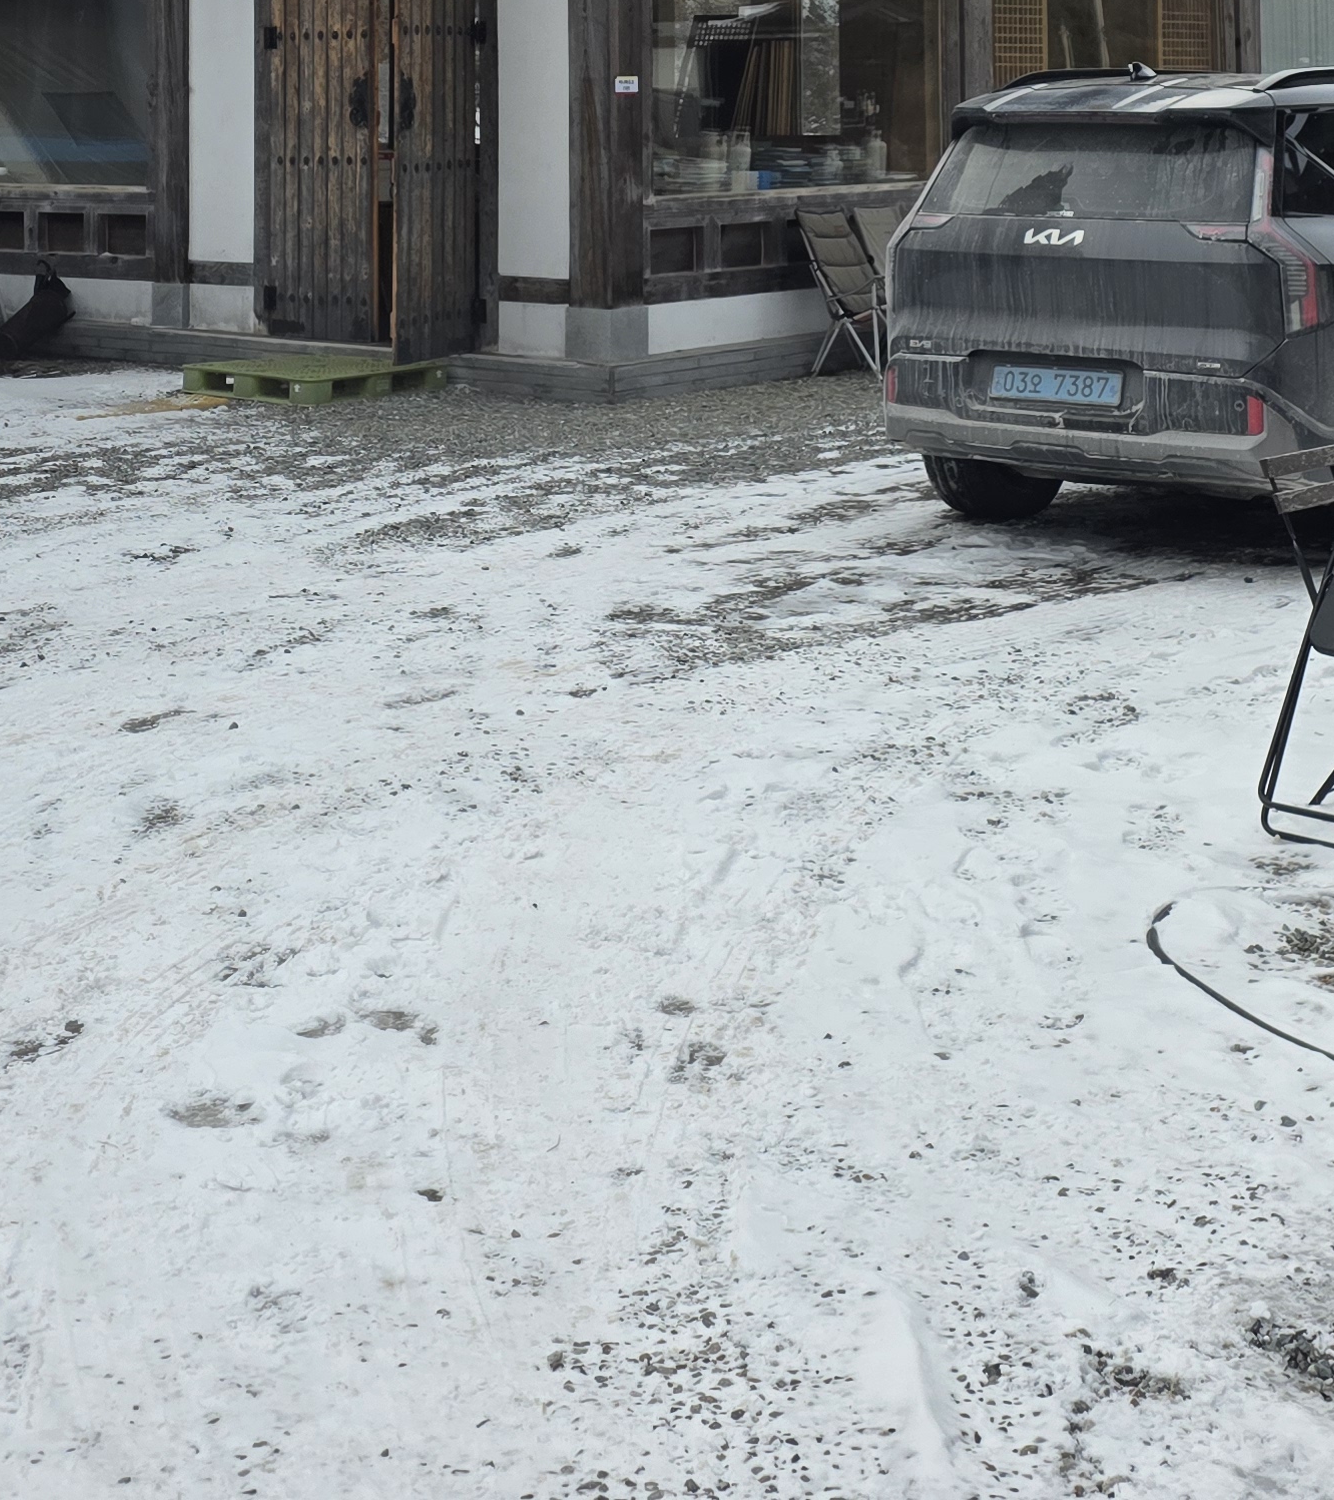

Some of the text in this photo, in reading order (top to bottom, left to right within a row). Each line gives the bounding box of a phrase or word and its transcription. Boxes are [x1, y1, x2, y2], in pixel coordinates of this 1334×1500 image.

[1023, 227, 1085, 246] KIA
[1003, 370, 1110, 399] 03오 7387
